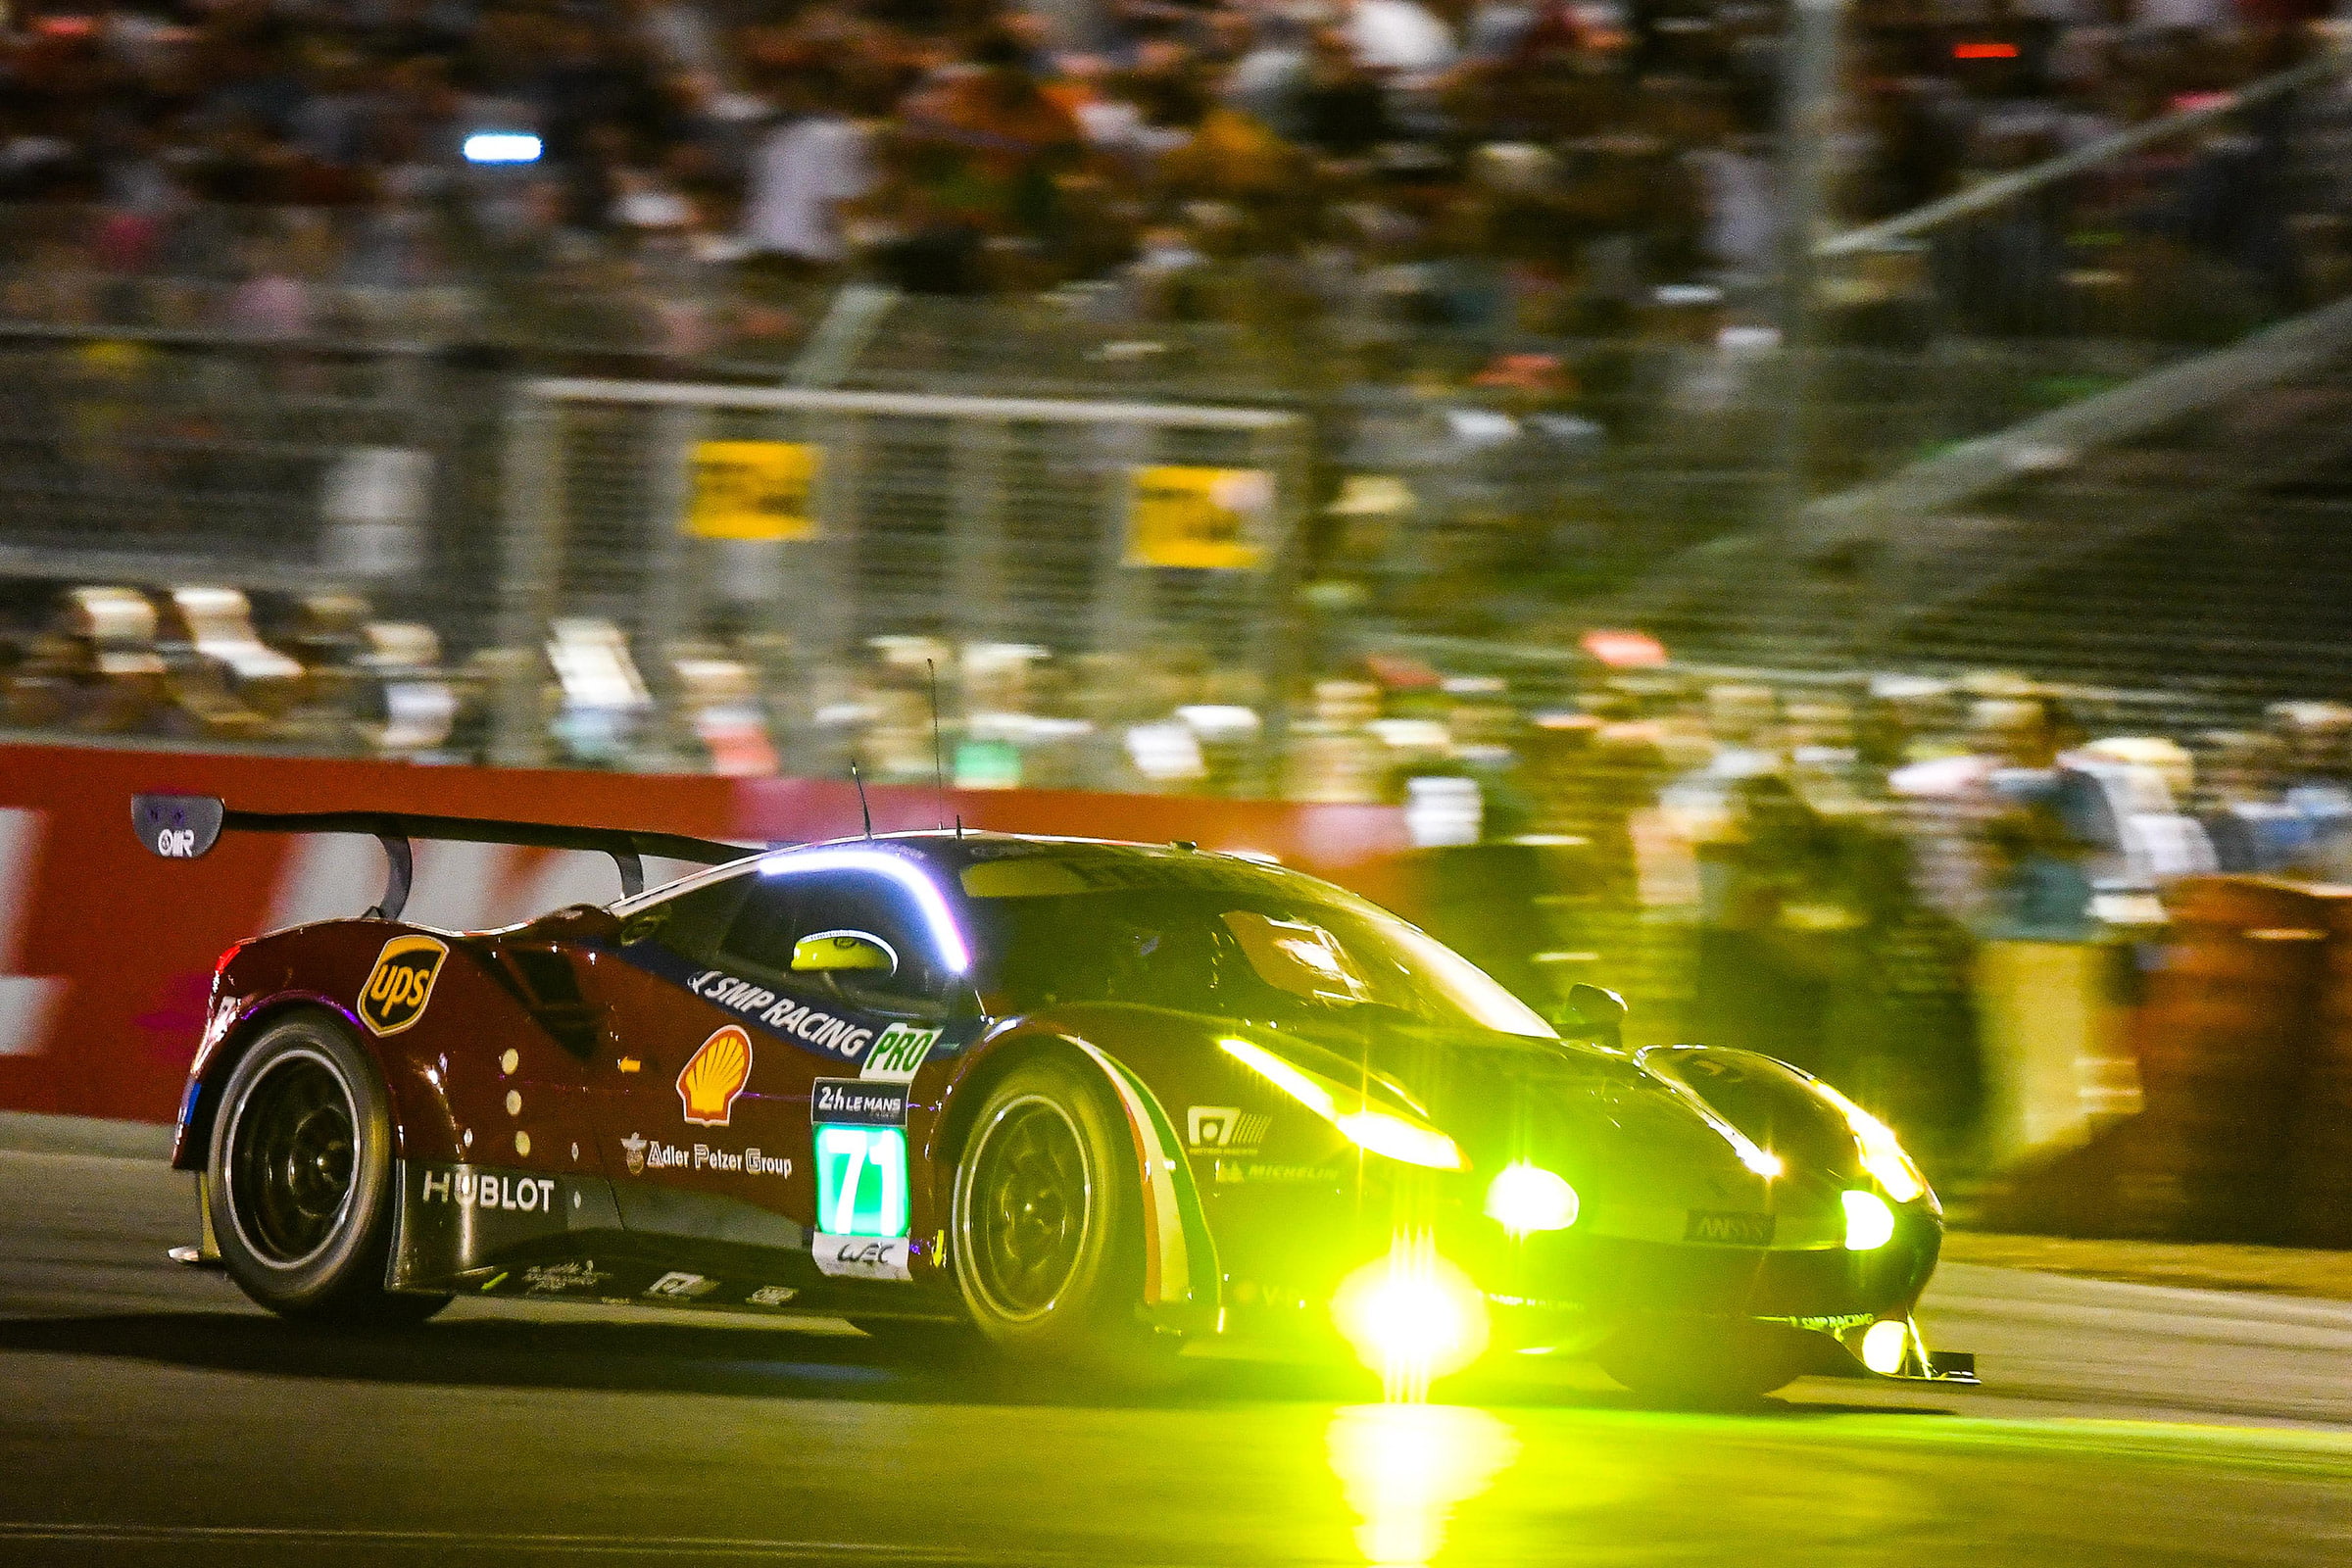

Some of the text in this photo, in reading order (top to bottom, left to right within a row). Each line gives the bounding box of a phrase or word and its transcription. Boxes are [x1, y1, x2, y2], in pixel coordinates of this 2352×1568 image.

[370, 963, 430, 1018] ups
[704, 974, 874, 1058] SMP RACING
[865, 1030, 934, 1072] PRO
[846, 1096, 862, 1112] LE
[863, 1097, 902, 1113] MANS
[646, 1140, 793, 1180] Adler Pelzer Group
[1248, 1163, 1340, 1182] MICHELIN
[422, 1169, 555, 1214] HUBLOT
[826, 1128, 898, 1238] 71
[837, 1242, 897, 1264] WEC
